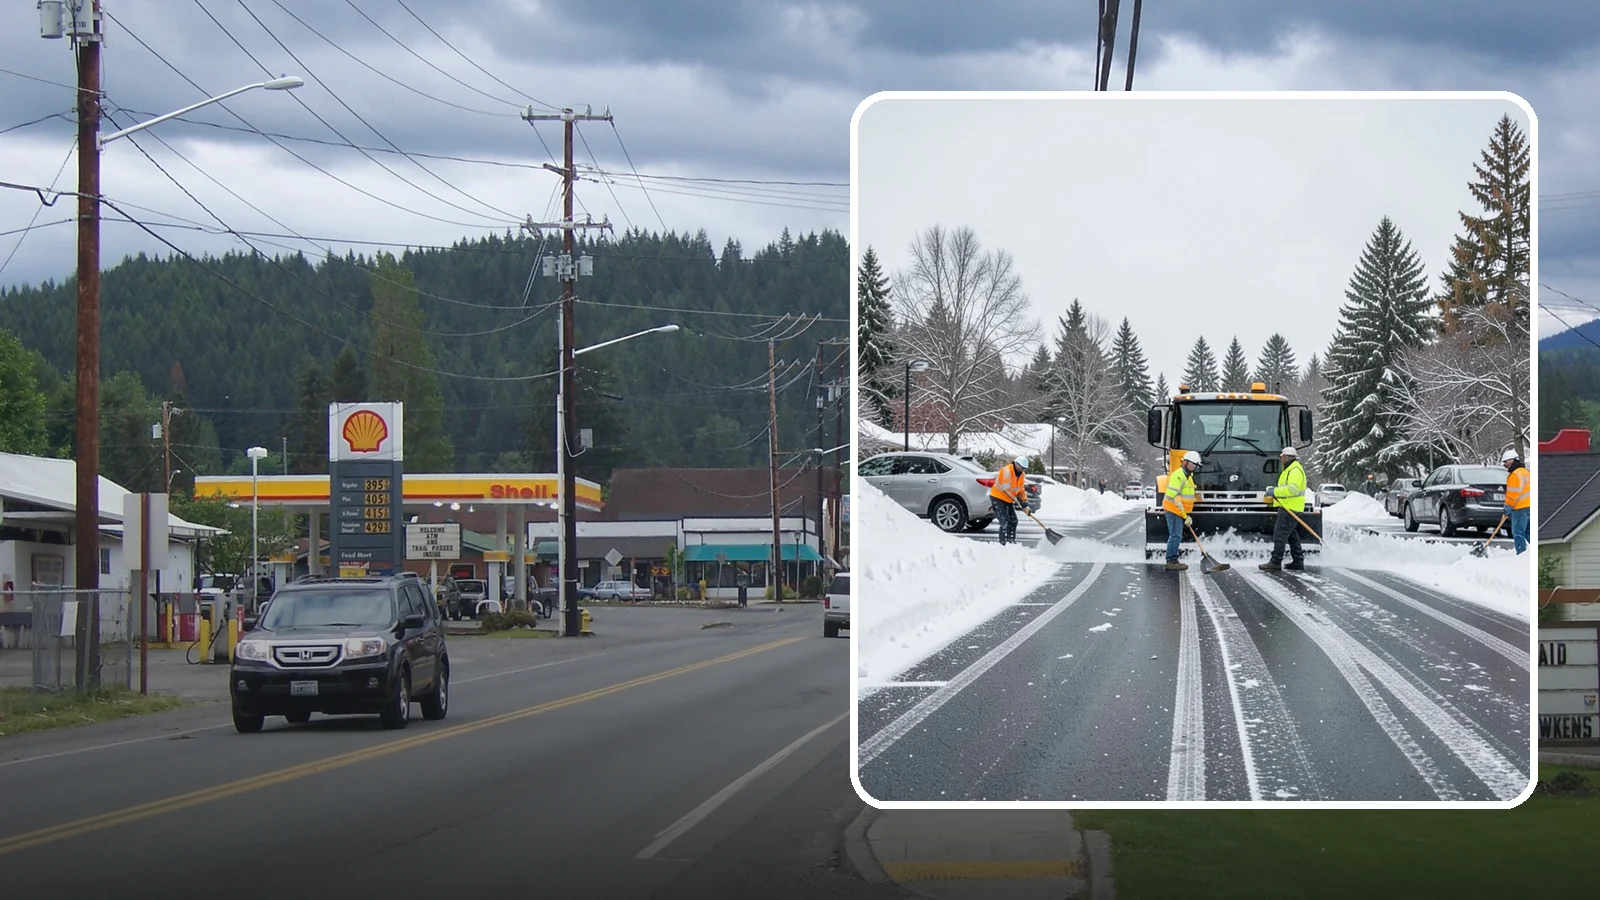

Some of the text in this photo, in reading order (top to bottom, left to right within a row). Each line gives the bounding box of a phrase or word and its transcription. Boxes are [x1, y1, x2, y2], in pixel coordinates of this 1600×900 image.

[365, 480, 384, 490] 395
[490, 484, 547, 499] Shell
[365, 494, 384, 504] 405
[365, 508, 384, 518] 415
[365, 522, 384, 532] 429
[1538, 642, 1566, 665] AID
